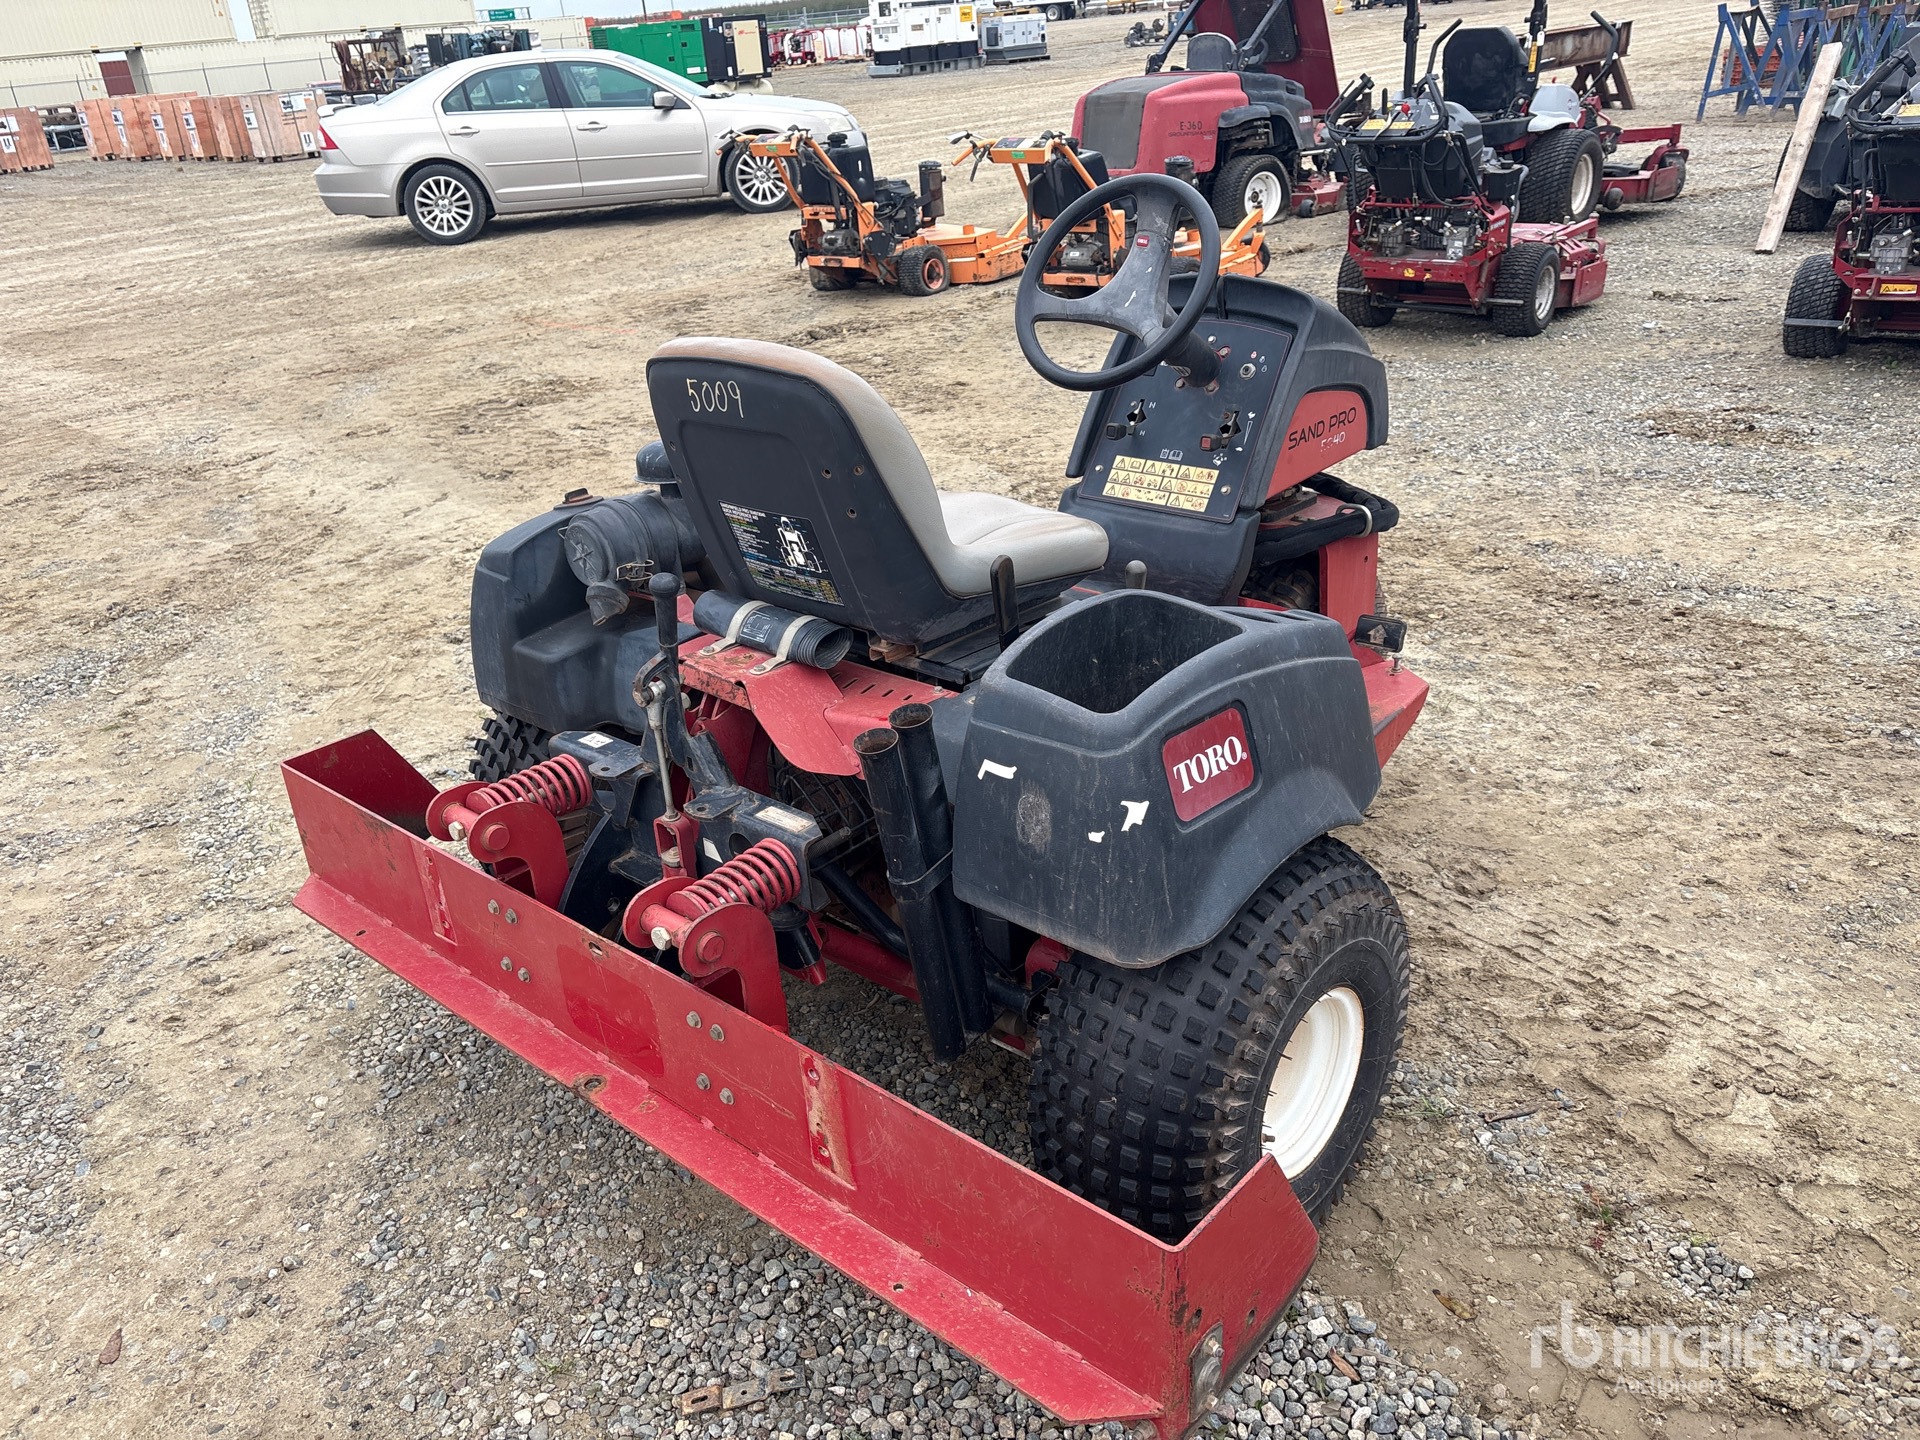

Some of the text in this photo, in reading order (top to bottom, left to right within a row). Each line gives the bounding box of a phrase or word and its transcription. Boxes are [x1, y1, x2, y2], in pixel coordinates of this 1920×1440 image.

[686, 378, 744, 419] 5009
[1287, 406, 1357, 450] SAND PRO
